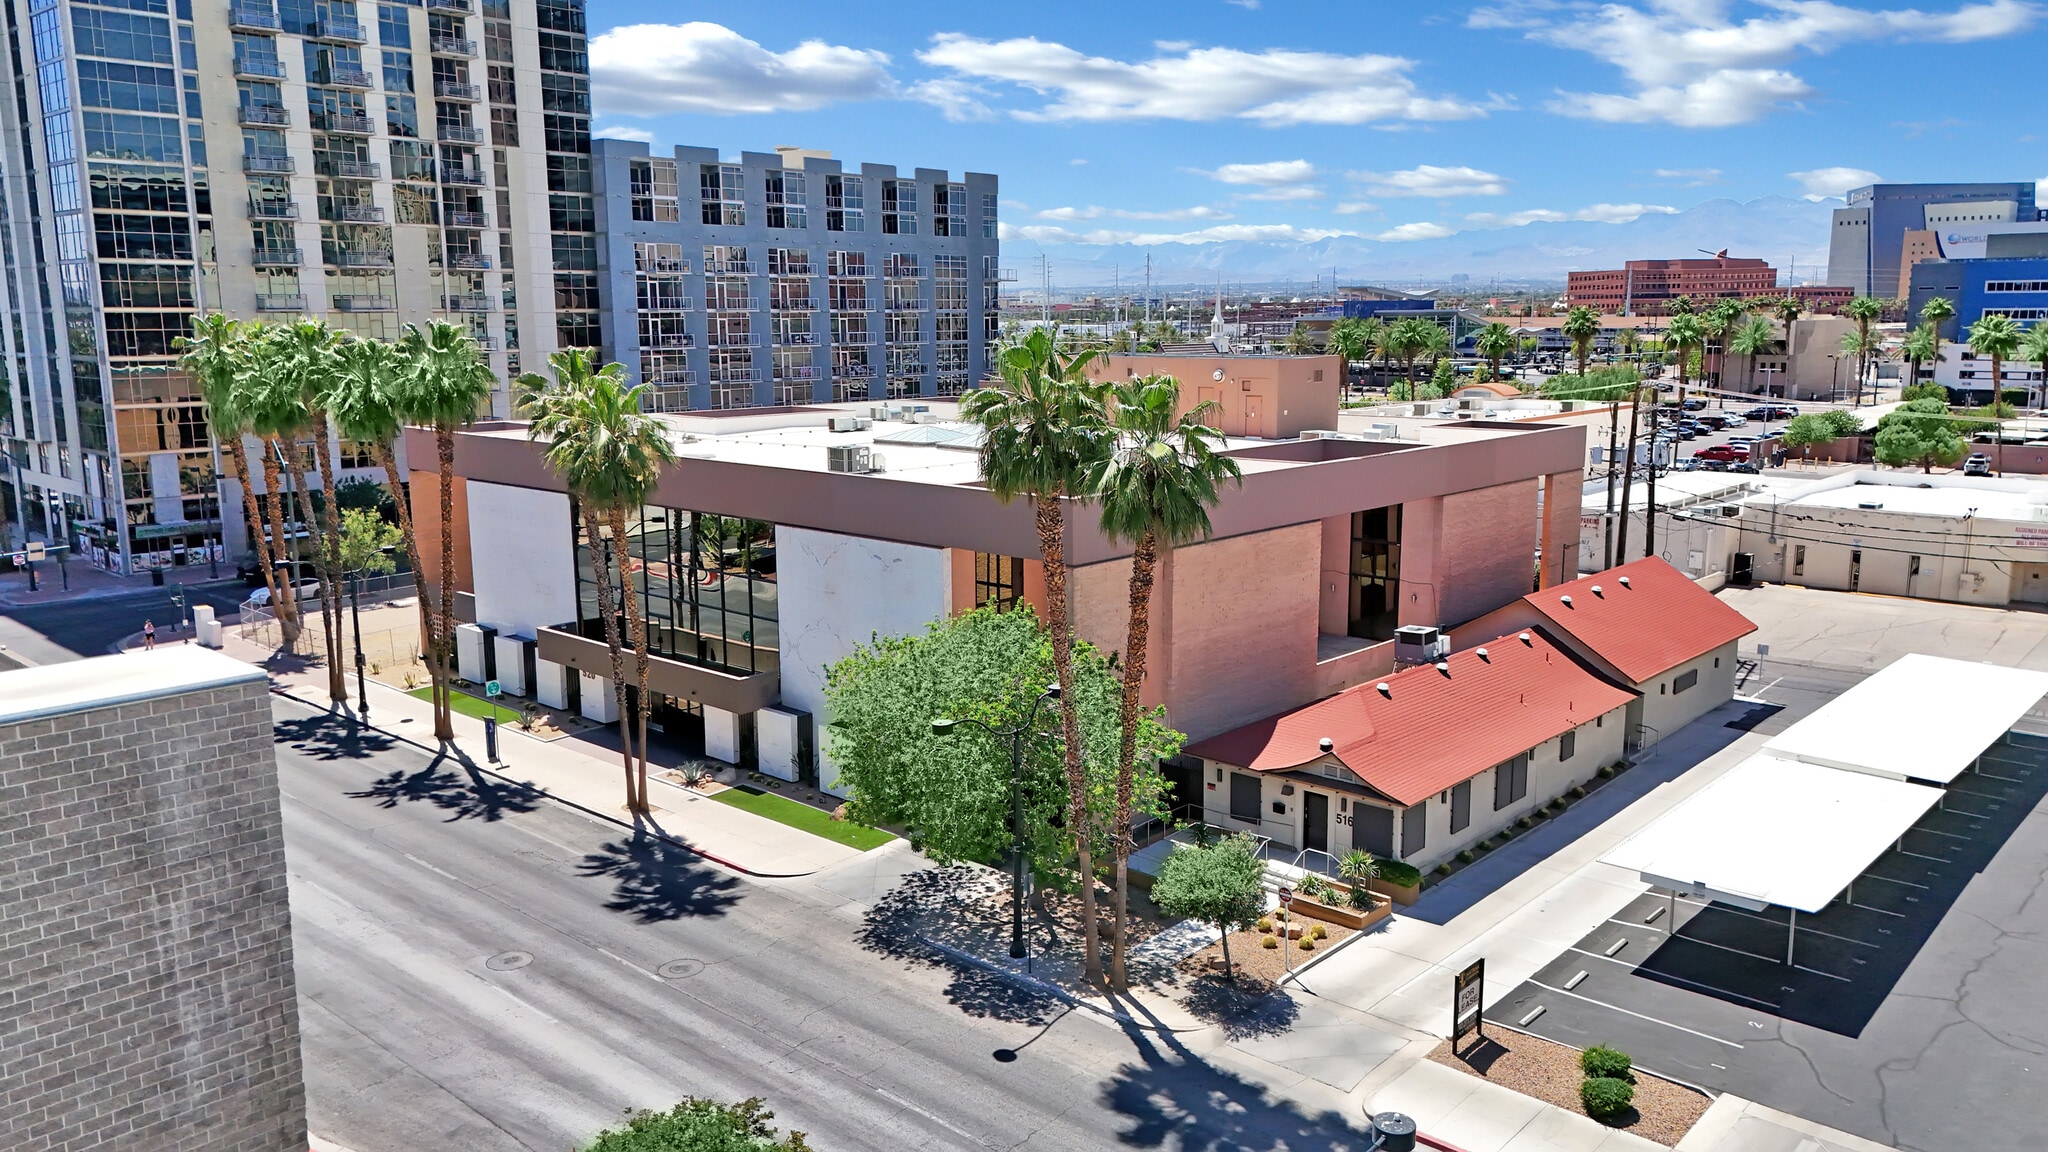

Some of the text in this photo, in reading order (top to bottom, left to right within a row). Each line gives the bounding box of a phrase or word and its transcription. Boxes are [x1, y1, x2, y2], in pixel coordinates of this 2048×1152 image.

[1336, 813, 1354, 827] 516
[1461, 987, 1475, 1002] FOR
[1781, 985, 1795, 993] 3
[1461, 994, 1478, 1012] EASE
[1748, 1021, 1764, 1029] 2
